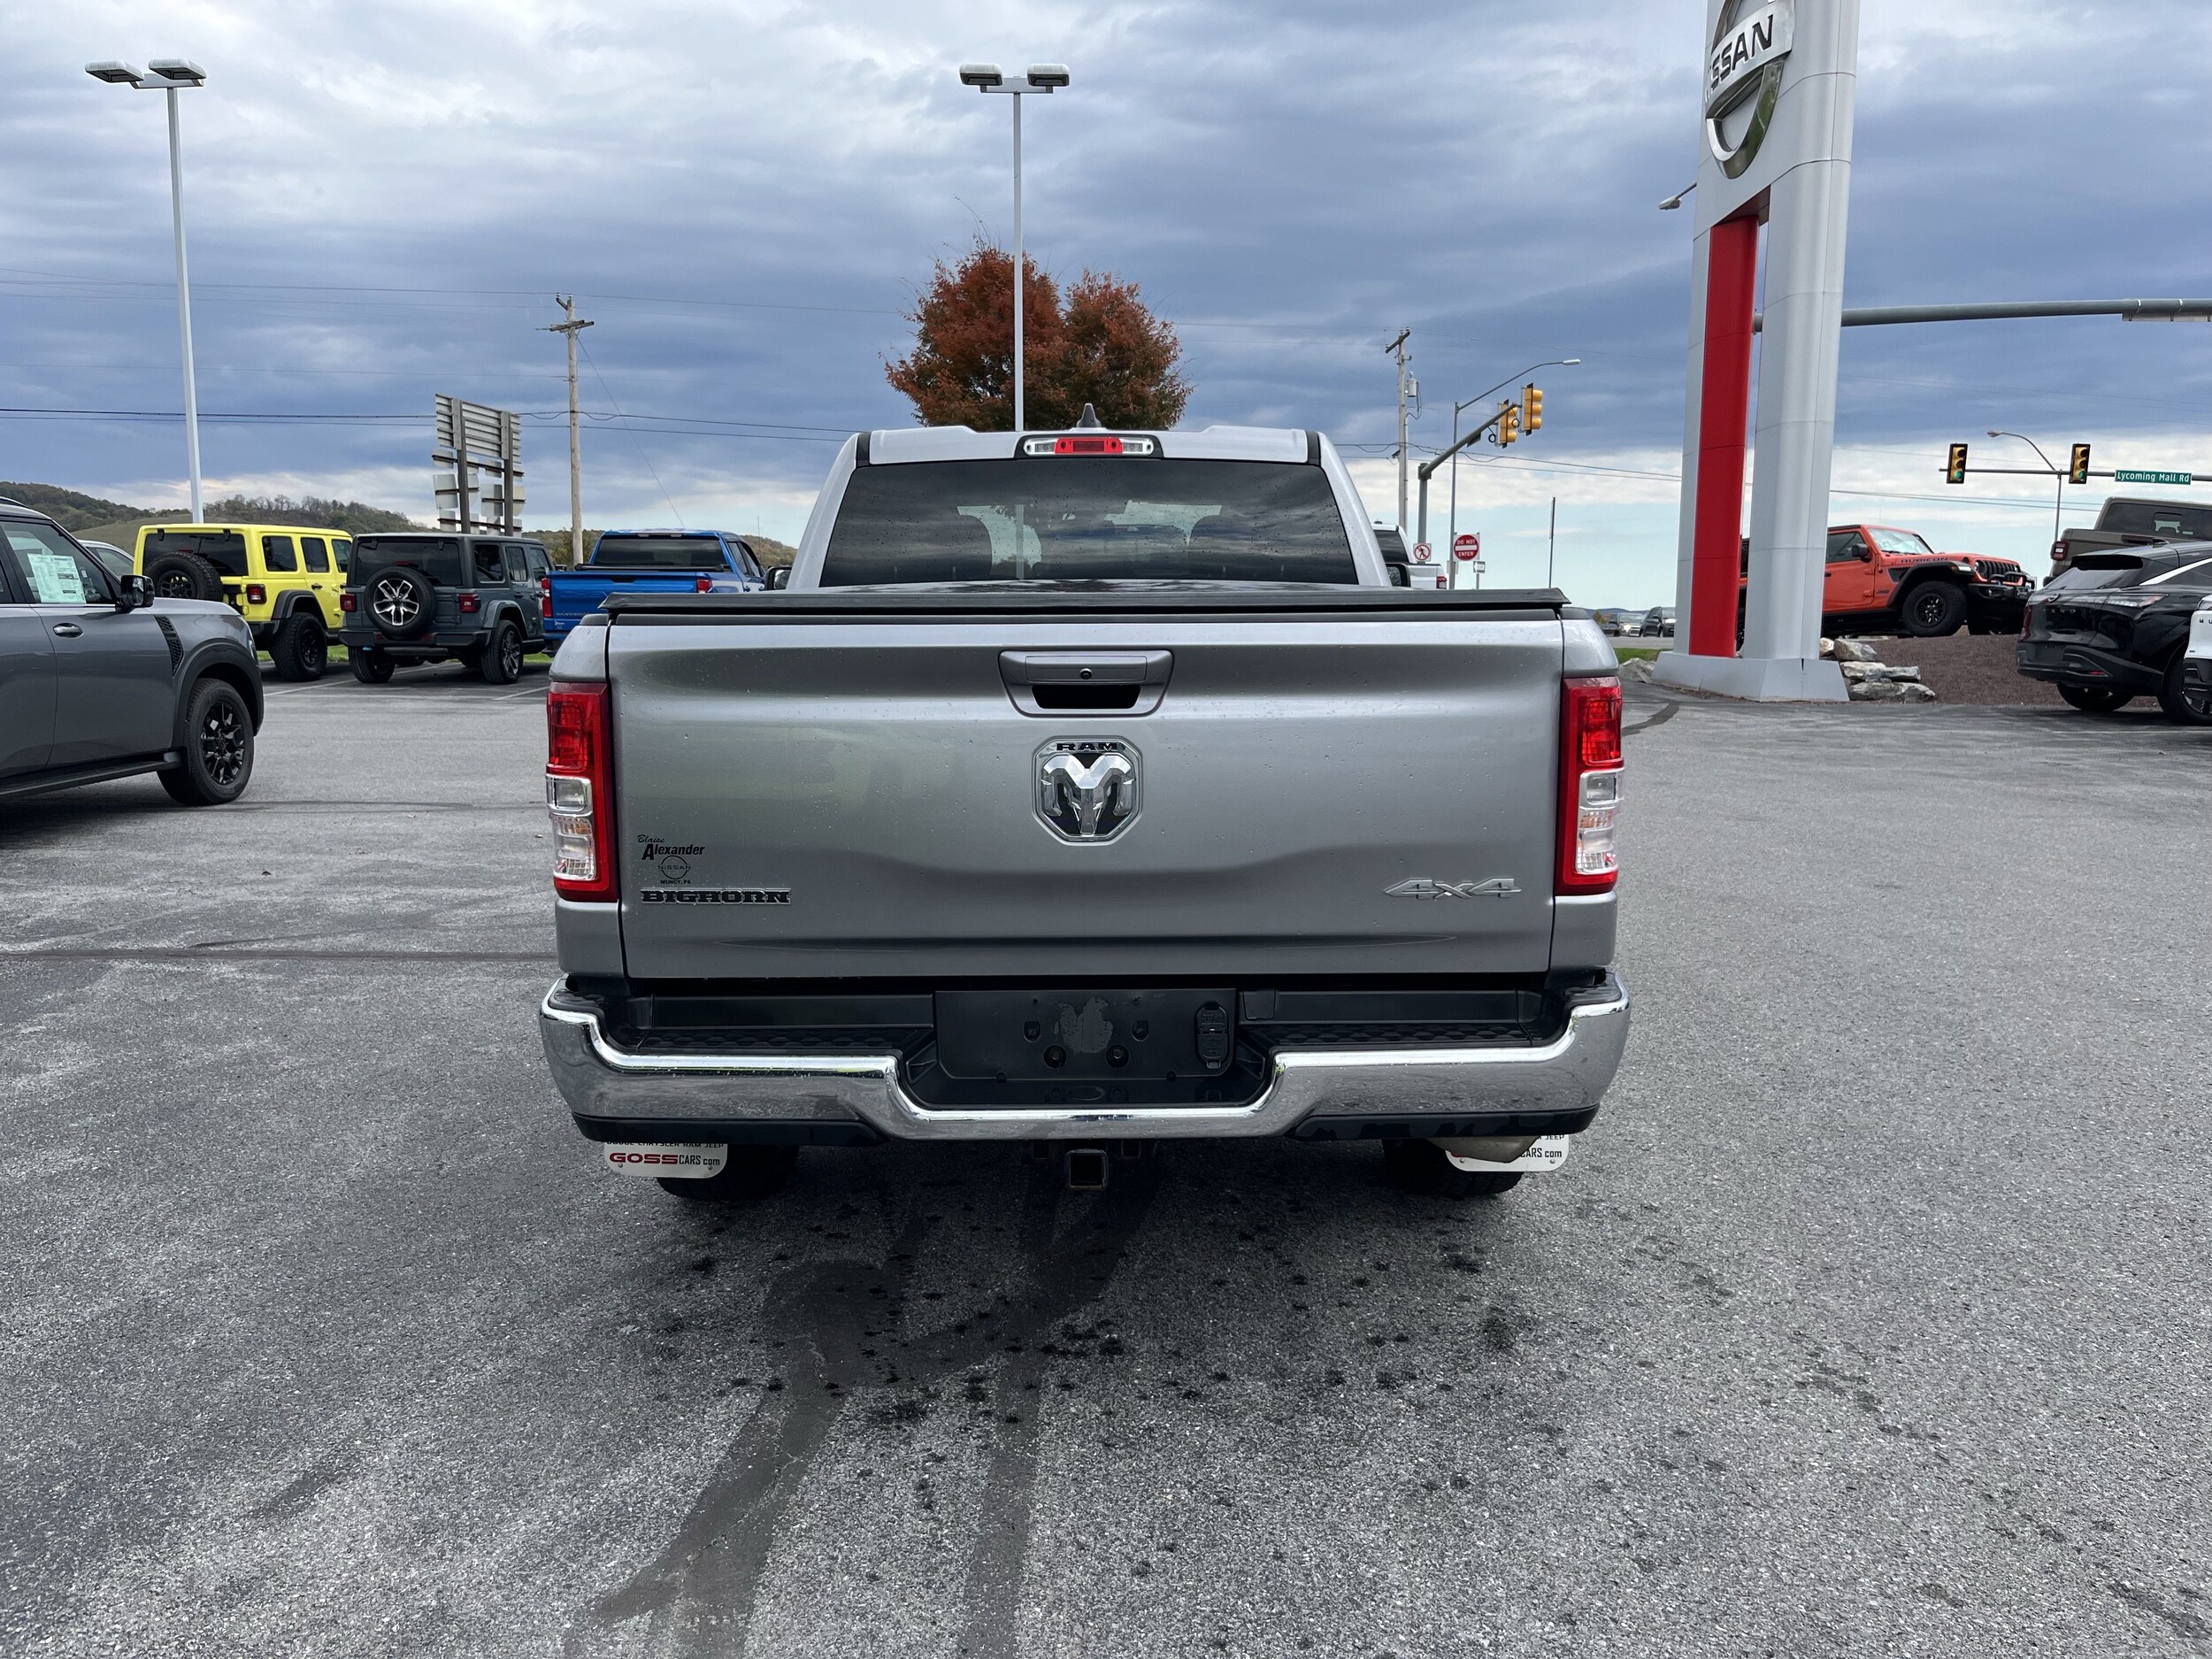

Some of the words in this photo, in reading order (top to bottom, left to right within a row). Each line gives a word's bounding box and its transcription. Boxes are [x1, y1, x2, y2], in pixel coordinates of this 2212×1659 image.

[1707, 14, 1774, 96] SSAN
[2117, 471, 2155, 482] Lycoming
[2159, 473, 2176, 482] Mall
[2178, 473, 2190, 482] Rd
[1056, 742, 1118, 751] RAM
[637, 833, 665, 843] Blaise
[641, 843, 706, 861] Alexander
[640, 887, 792, 904] BIGHORN
